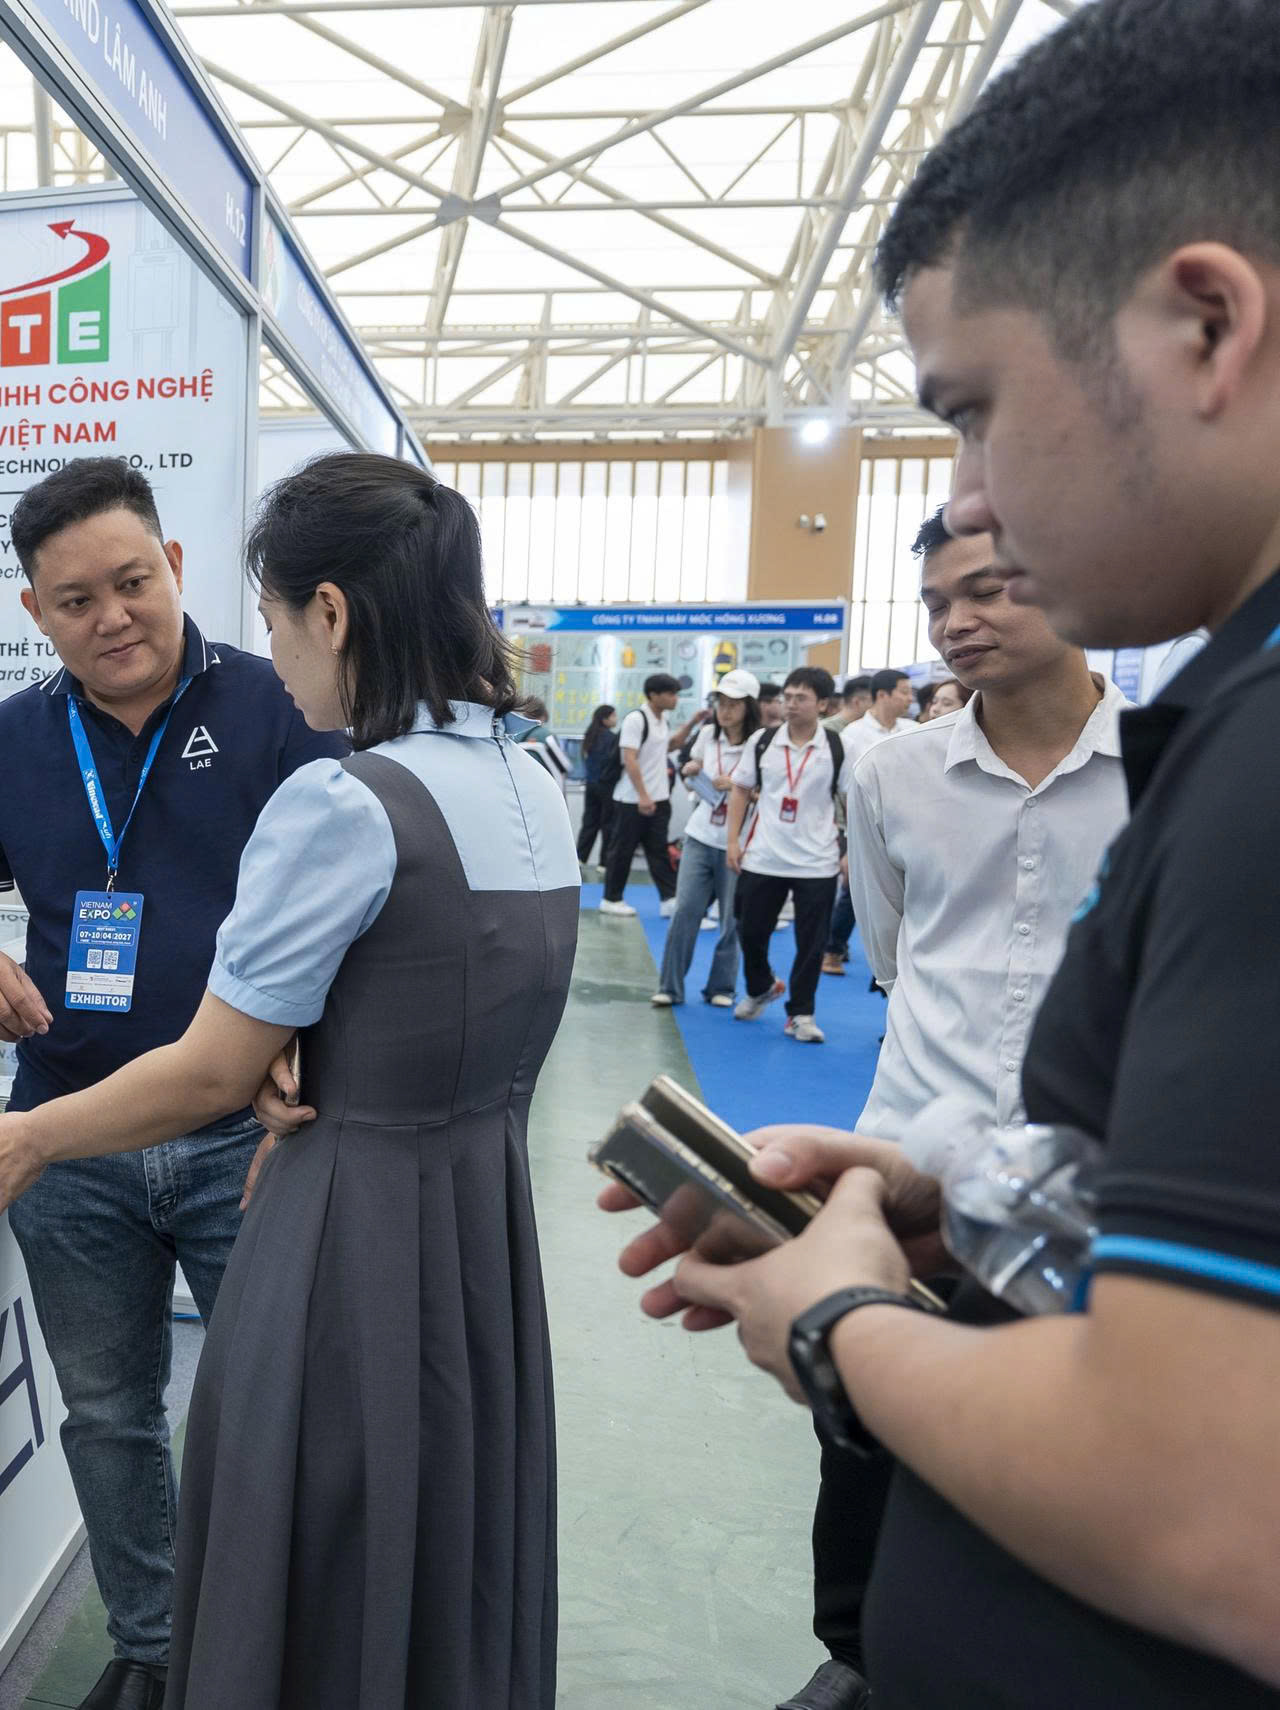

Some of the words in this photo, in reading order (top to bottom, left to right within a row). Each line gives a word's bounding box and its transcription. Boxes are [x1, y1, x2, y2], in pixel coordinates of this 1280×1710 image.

[63, 0, 100, 44] ND
[104, 16, 136, 98] LÂM
[139, 70, 168, 141] ANH
[226, 192, 247, 247] H.12
[48, 377, 130, 405] CÔNG
[137, 369, 214, 402] NGHỆ
[54, 421, 117, 444] NAM
[159, 453, 193, 470] LTD
[622, 614, 635, 625] TY
[189, 758, 212, 771] LAE
[80, 901, 113, 909] VIETNAM
[79, 909, 111, 920] EXPO
[70, 993, 127, 1007] EXHIBITOR
